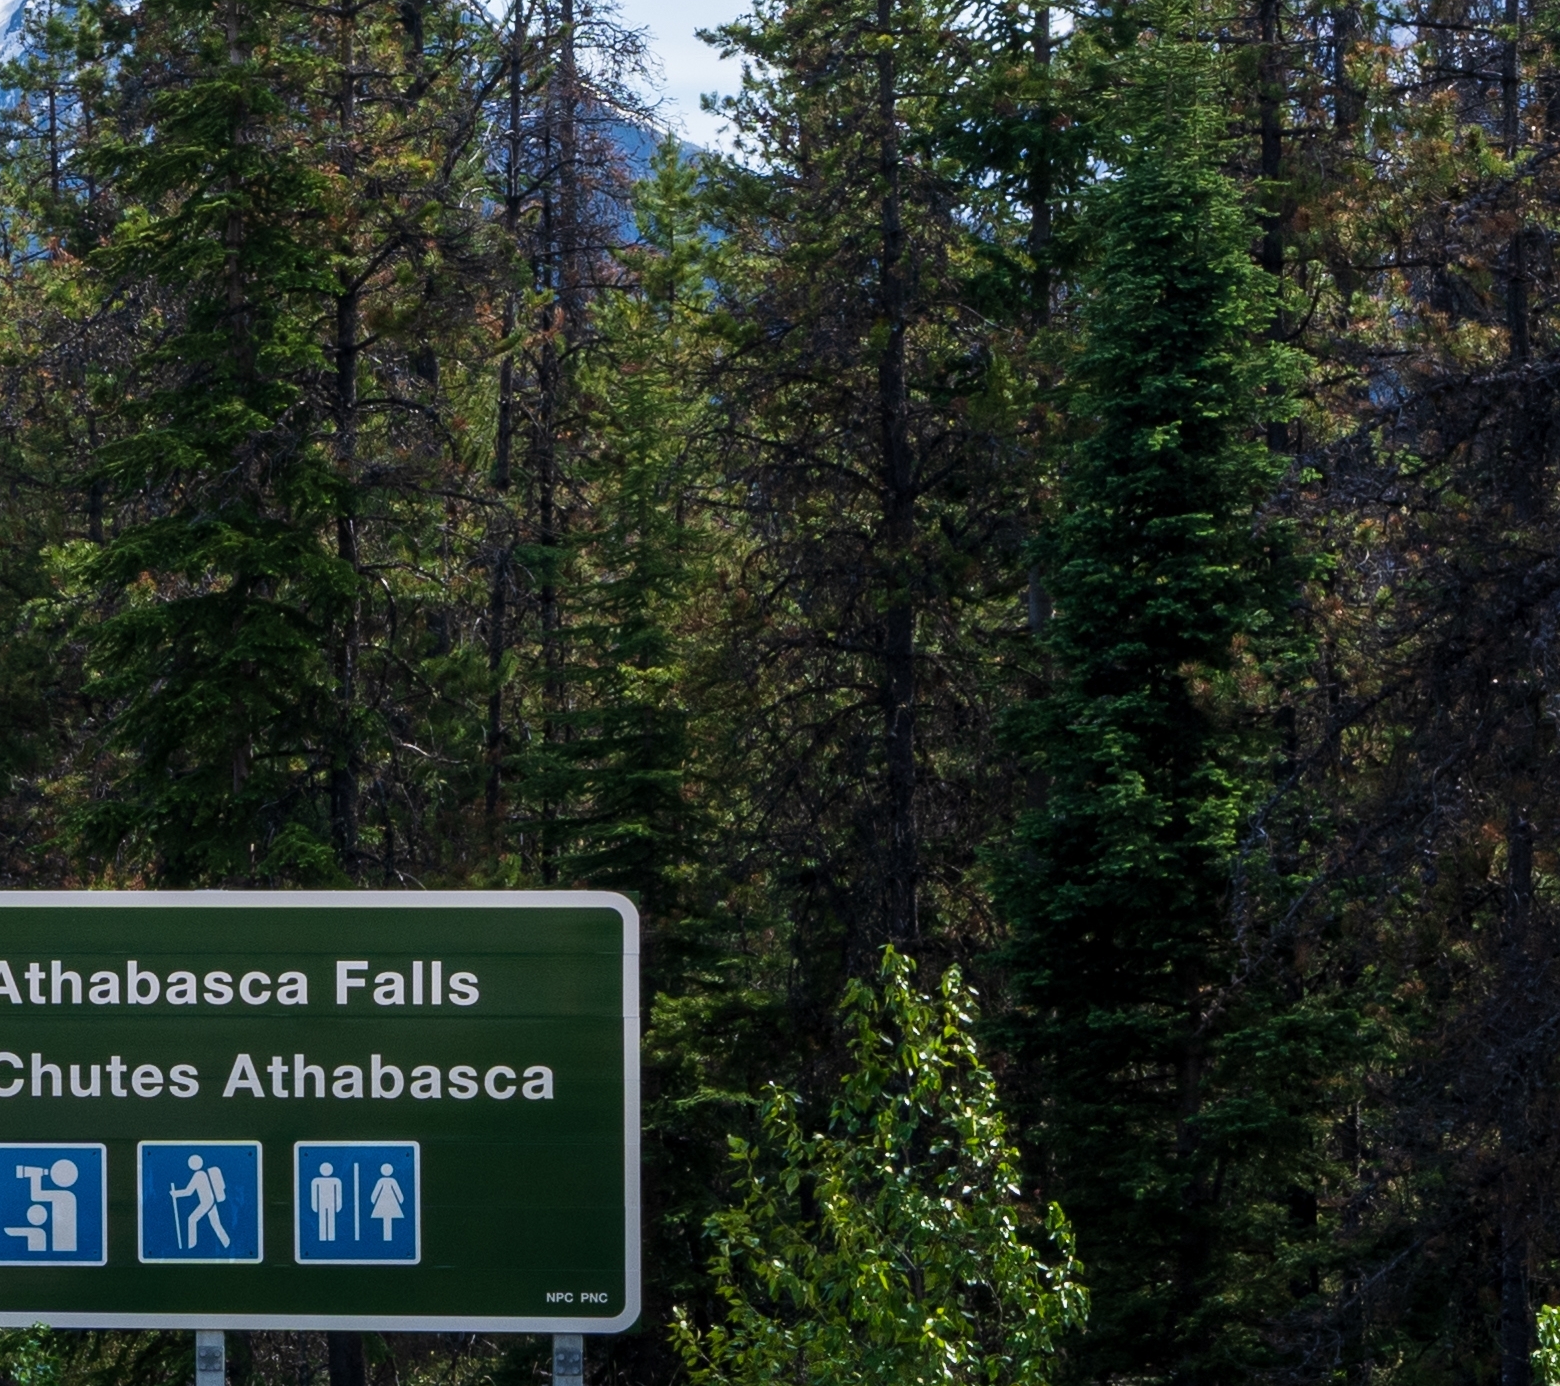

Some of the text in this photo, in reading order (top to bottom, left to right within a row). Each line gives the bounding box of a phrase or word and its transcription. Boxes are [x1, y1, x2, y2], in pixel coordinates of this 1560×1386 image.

[336, 960, 480, 1006] Falls
[222, 1053, 554, 1100] Athabasca
[546, 1292, 608, 1304] NPC PNC
